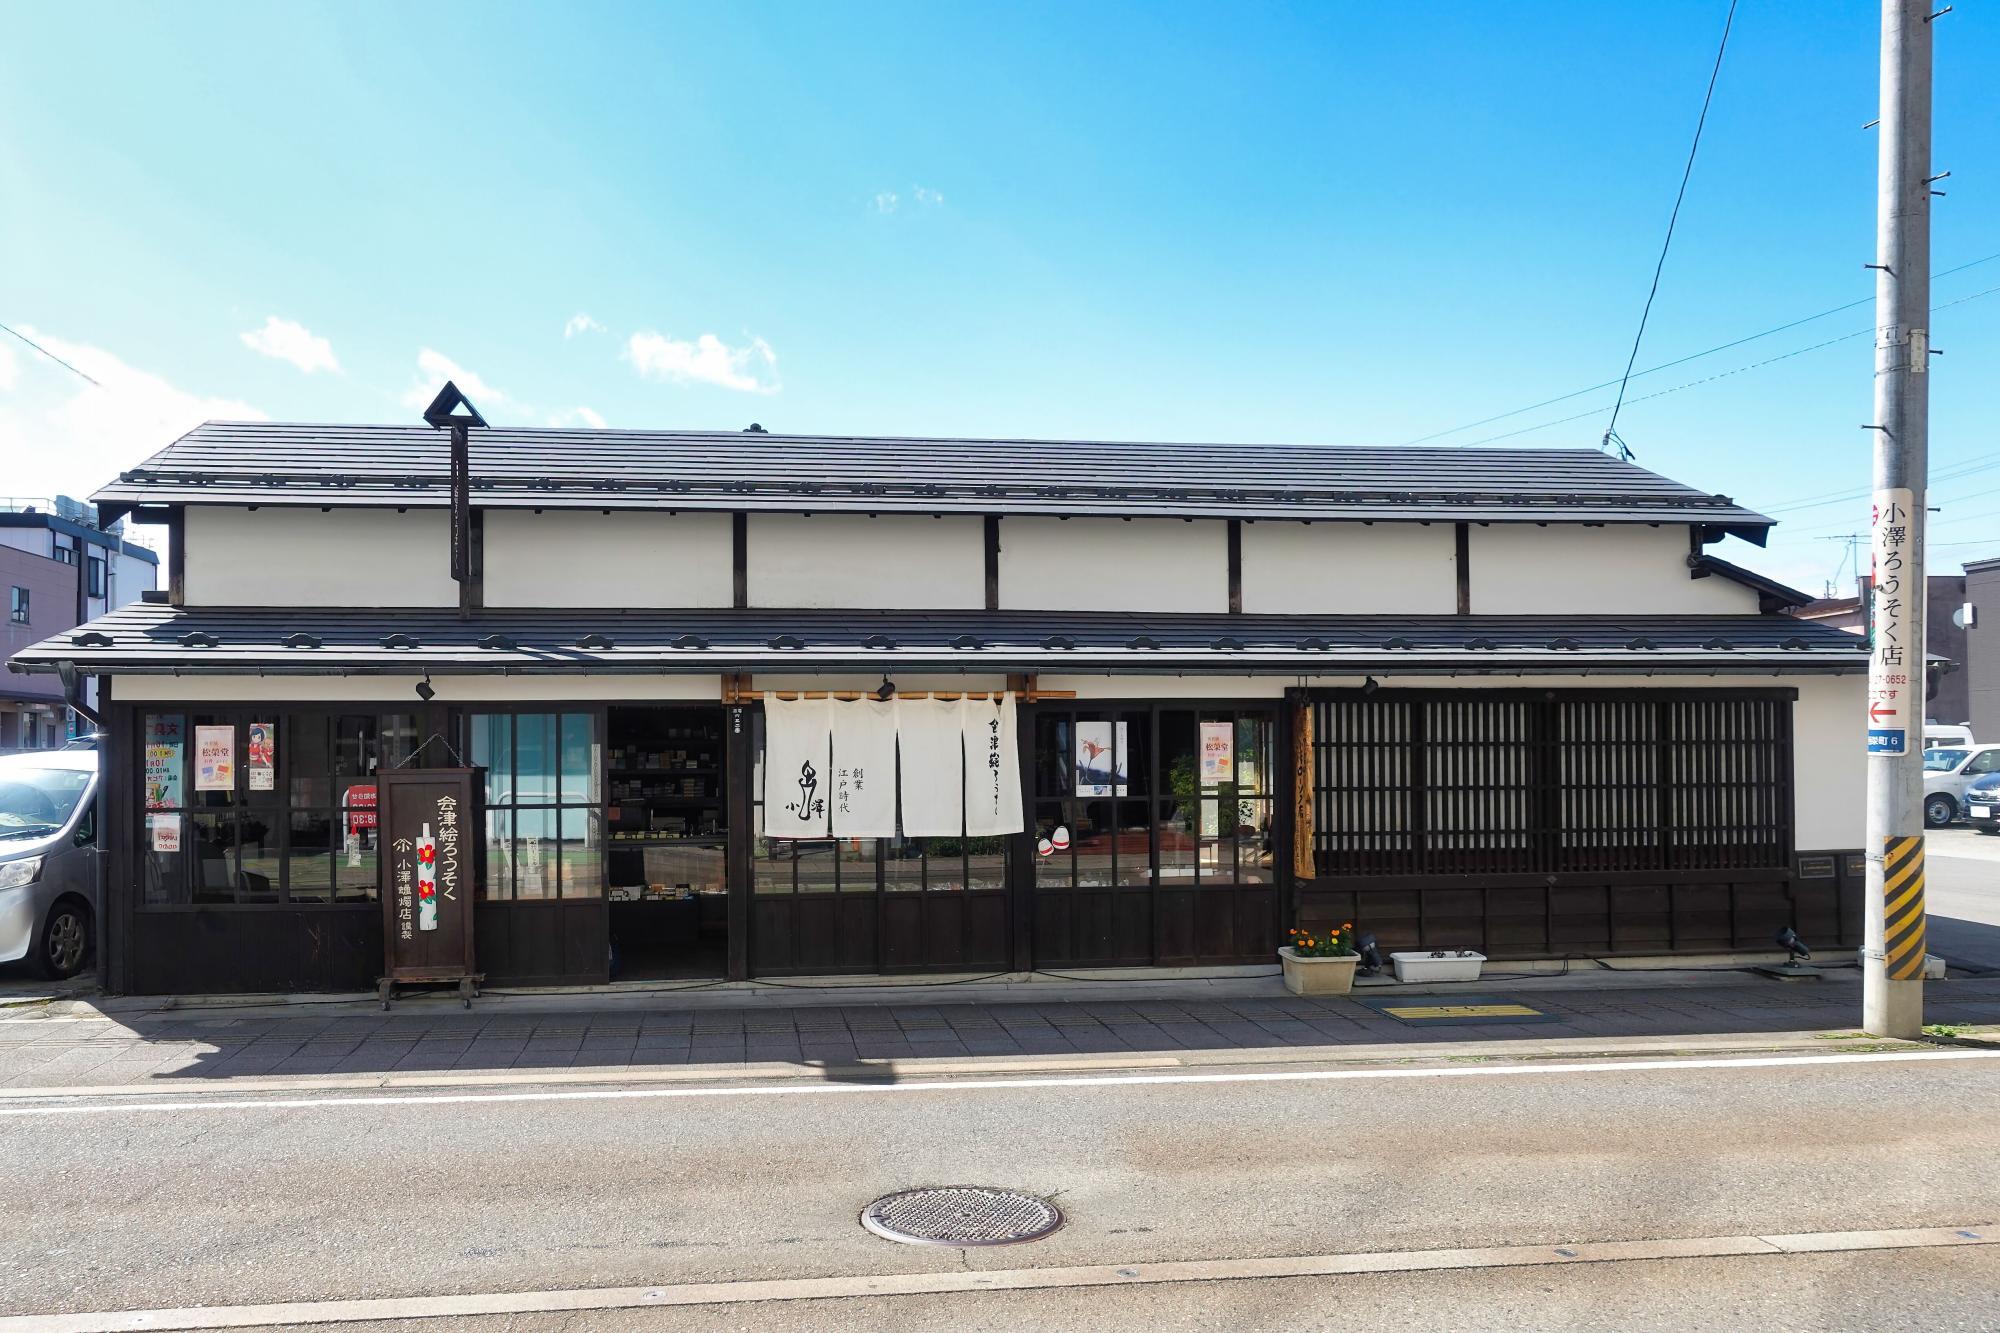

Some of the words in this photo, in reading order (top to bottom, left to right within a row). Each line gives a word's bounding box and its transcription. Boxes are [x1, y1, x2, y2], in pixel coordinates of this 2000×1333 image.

[1881, 502, 1906, 667] 小澤ろうそく店
[1868, 690, 1899, 700] こです
[1890, 736, 1898, 745] 6
[838, 768, 850, 813] 江戸時代
[852, 768, 864, 790] 創業
[437, 795, 459, 901] 会津絵ろうそく
